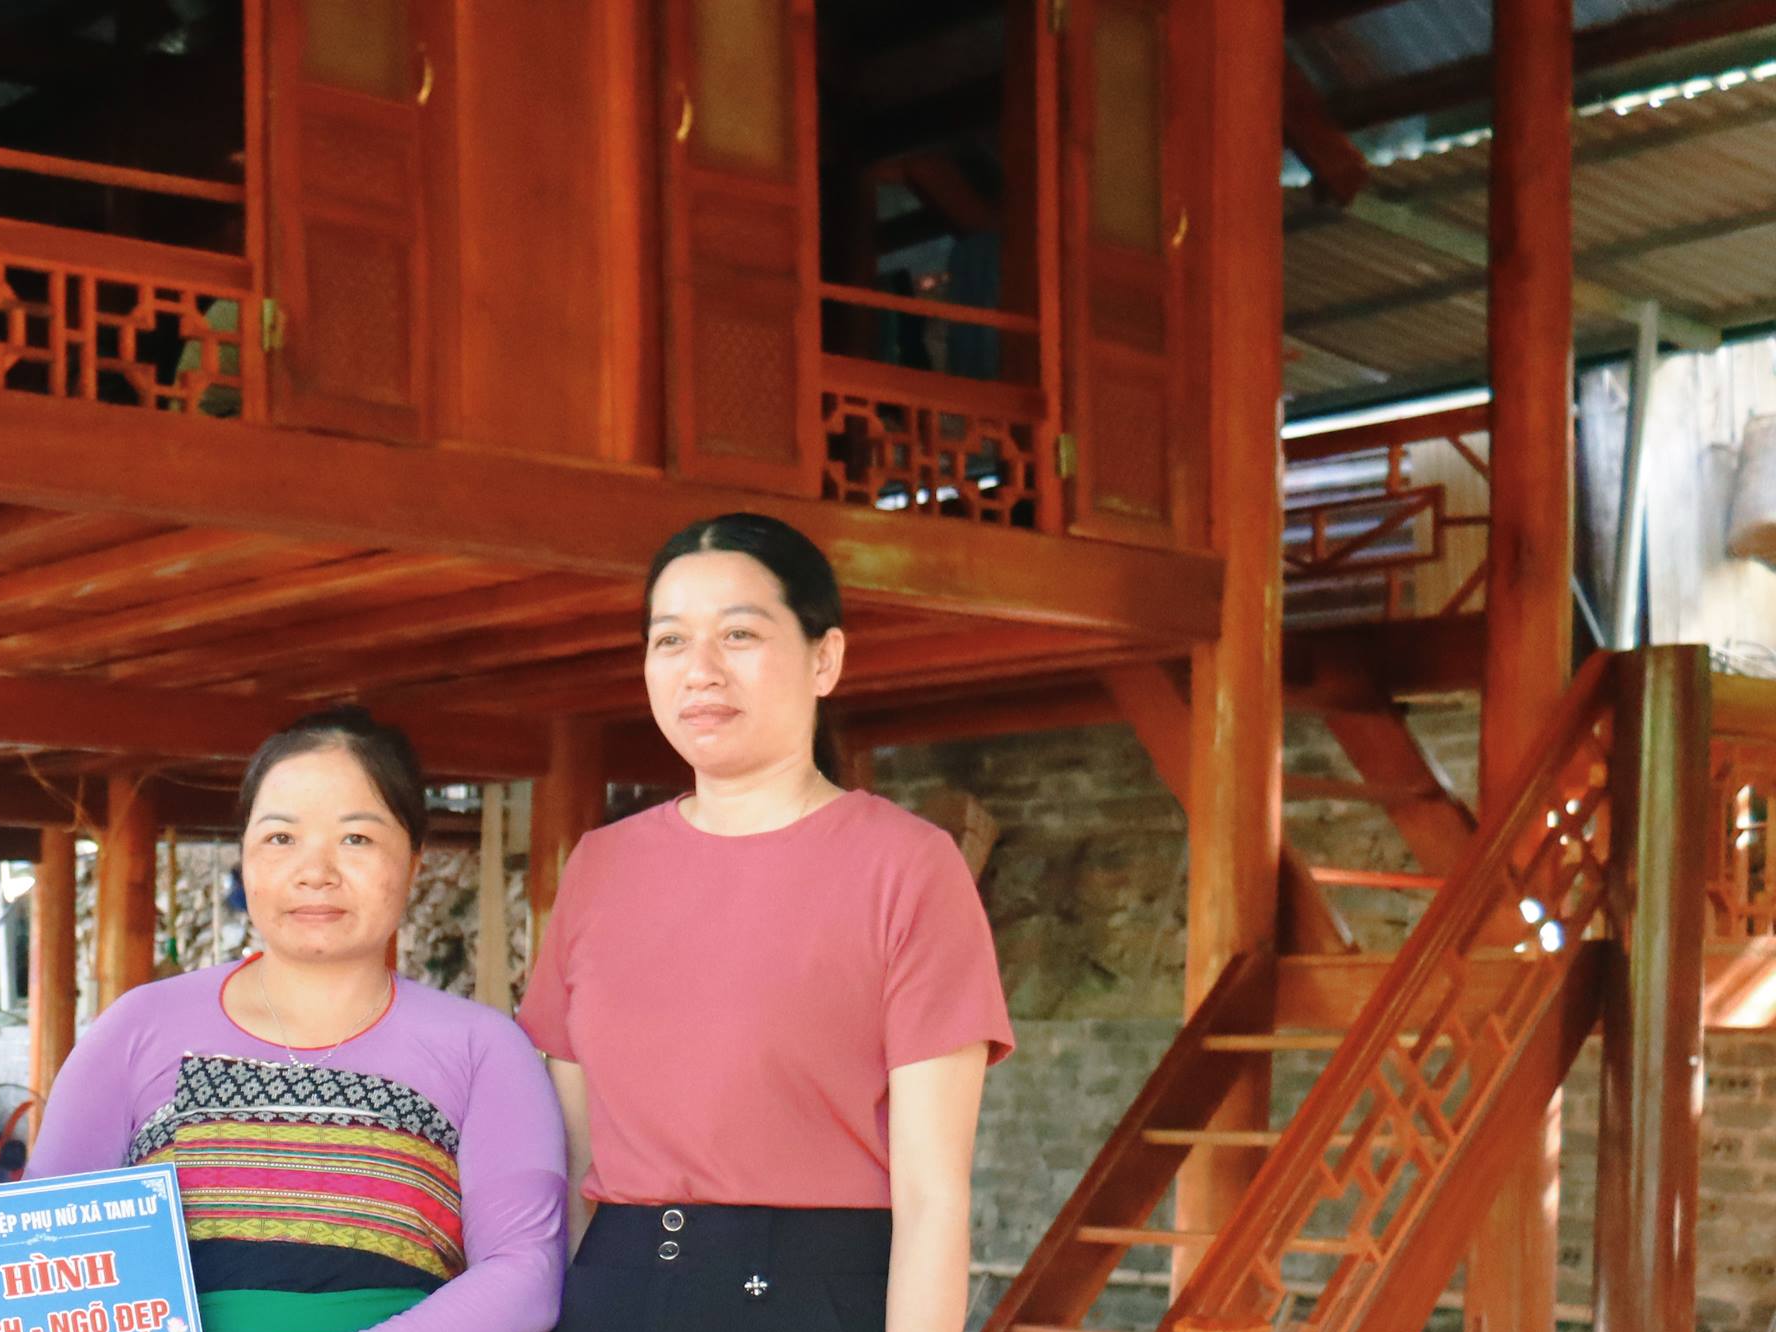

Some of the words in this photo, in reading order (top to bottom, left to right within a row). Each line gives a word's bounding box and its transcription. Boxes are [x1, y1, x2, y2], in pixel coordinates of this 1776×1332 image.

[21, 1209, 52, 1232] PHỤ
[55, 1203, 77, 1226] NỮ
[79, 1200, 102, 1223] XÃ
[103, 1199, 136, 1220] TAM
[137, 1194, 158, 1216] LƯ
[1, 1252, 118, 1298] HÌNH
